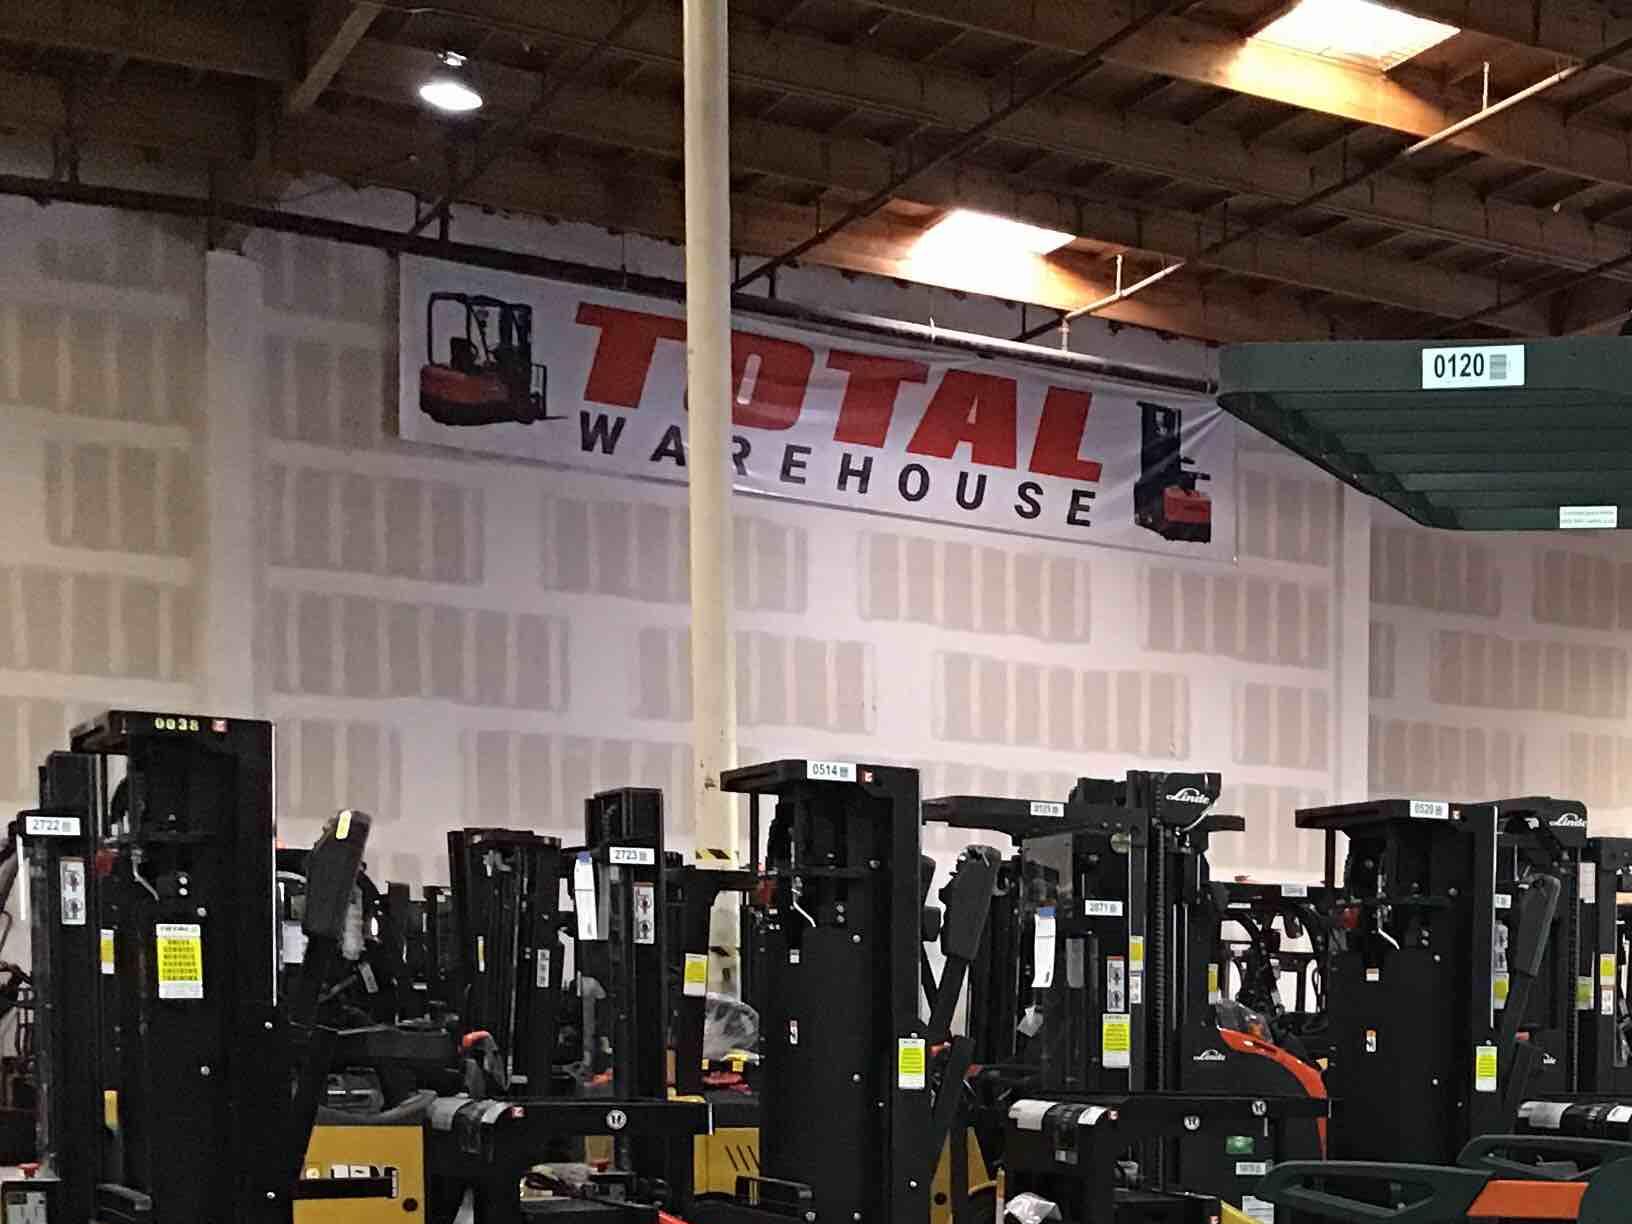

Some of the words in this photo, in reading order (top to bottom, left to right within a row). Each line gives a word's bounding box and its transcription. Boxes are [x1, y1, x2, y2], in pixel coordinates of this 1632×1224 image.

[1434, 353, 1484, 378] 0120
[575, 302, 1103, 482] TOTAL
[812, 763, 838, 776] 0514
